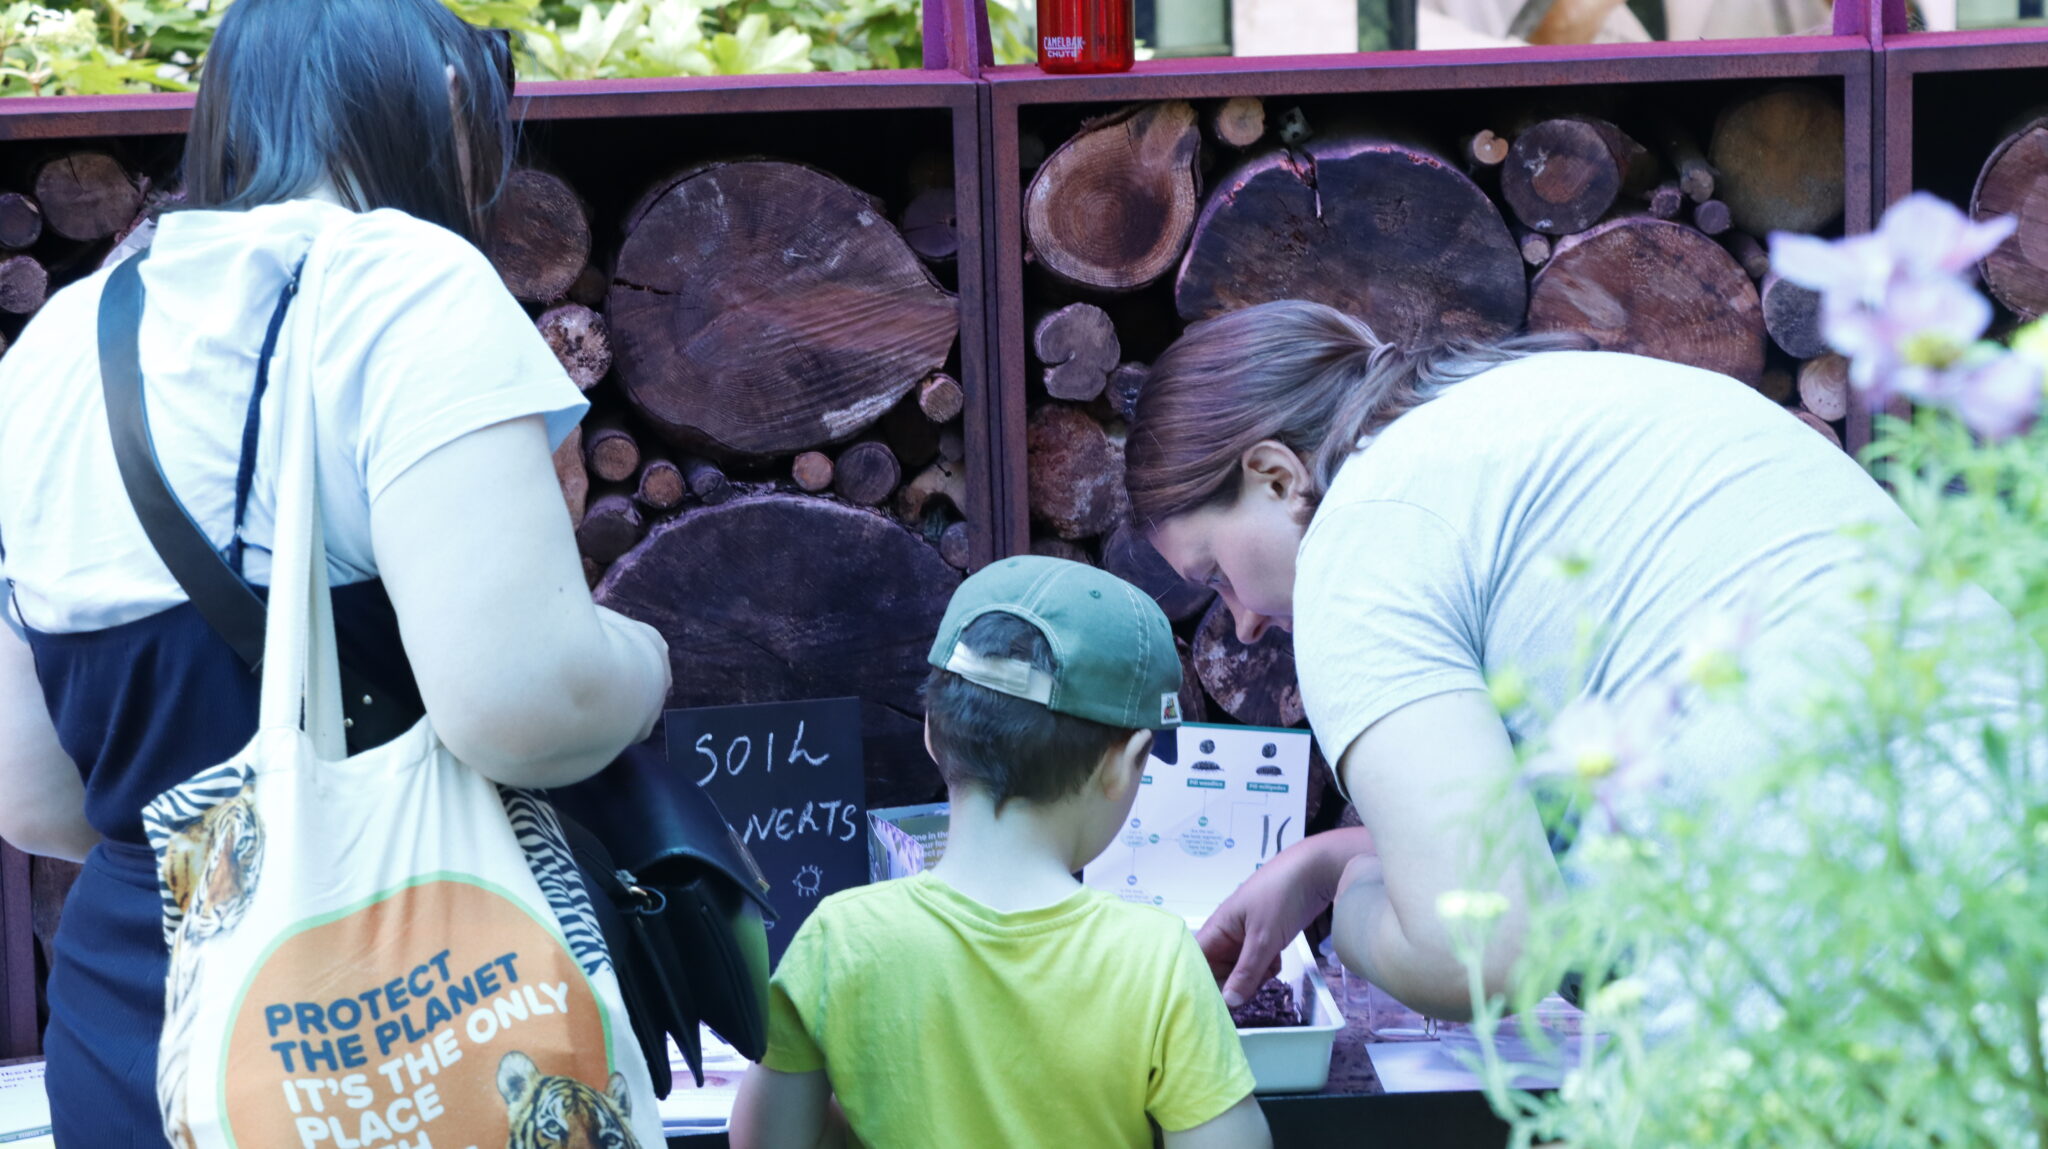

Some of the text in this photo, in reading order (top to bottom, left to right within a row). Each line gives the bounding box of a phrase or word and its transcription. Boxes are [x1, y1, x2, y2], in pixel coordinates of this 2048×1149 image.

[1043, 36, 1084, 50] CAMELBAK
[695, 720, 830, 787] SOIL
[264, 949, 452, 1037] PROTECT
[270, 951, 519, 1073] THE PLANET
[282, 981, 570, 1114] IT'S THE ONLY
[294, 1082, 446, 1149] PLACE
